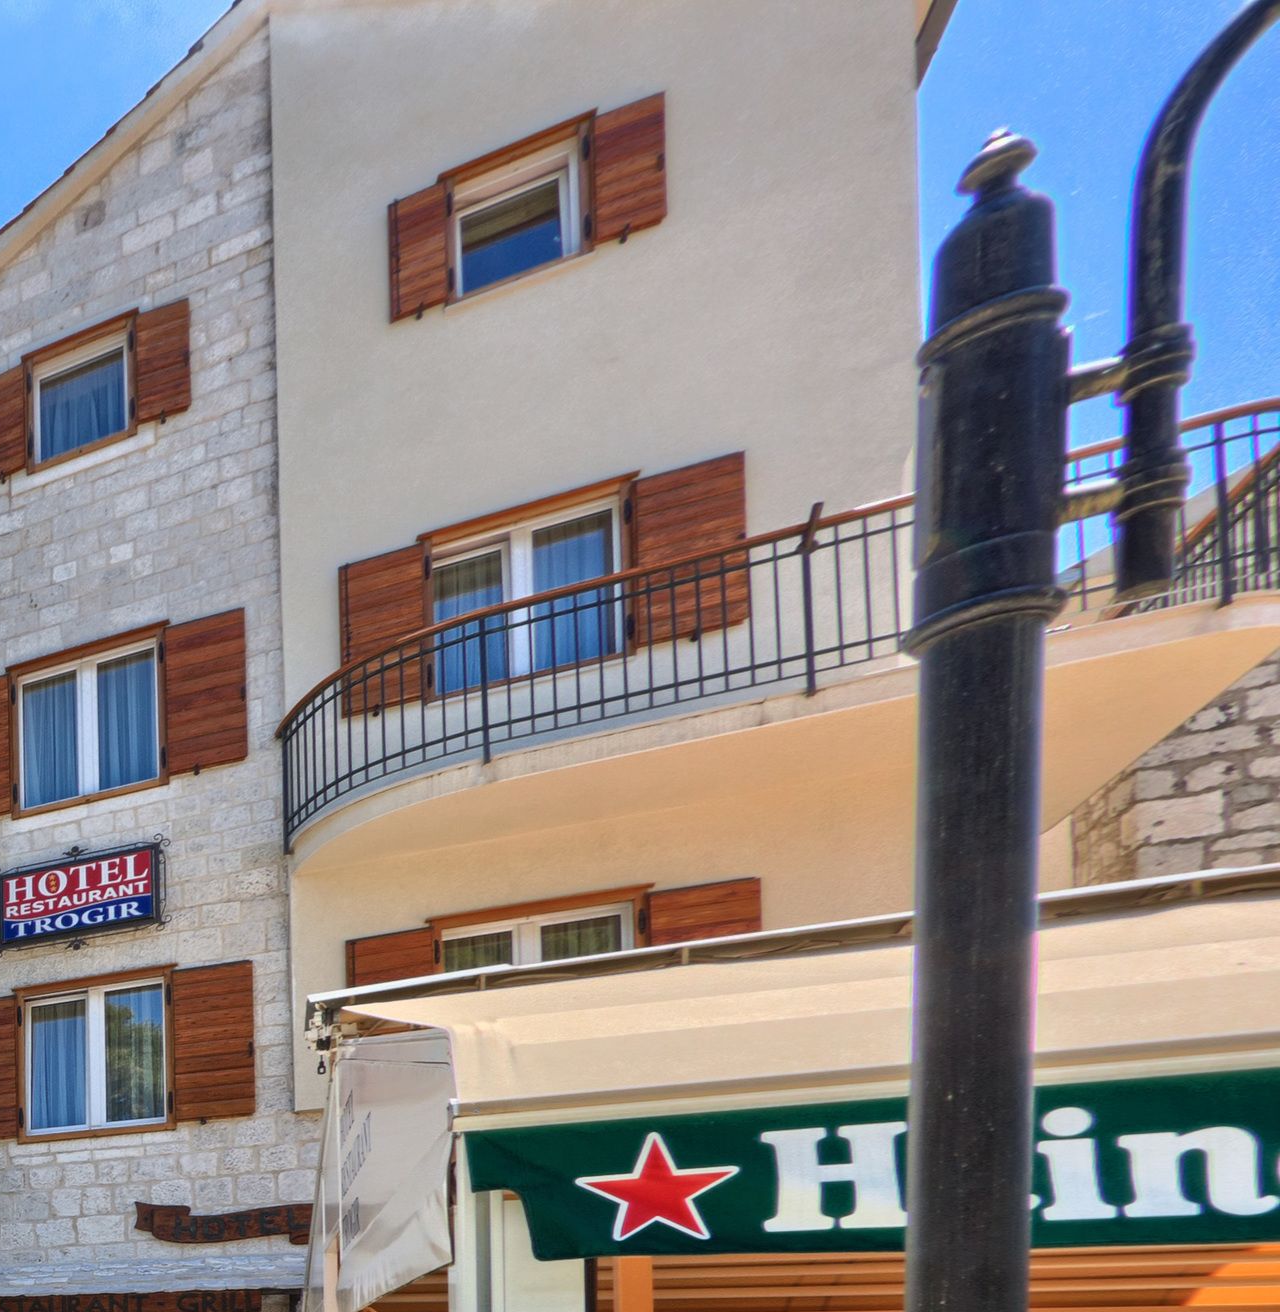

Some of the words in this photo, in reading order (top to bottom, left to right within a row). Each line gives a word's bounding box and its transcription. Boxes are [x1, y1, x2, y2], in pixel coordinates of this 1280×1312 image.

[5, 854, 150, 905] HOTEL
[5, 880, 148, 918] RESTAURANT
[10, 900, 143, 938] TROGIR
[759, 1106, 1280, 1233] Hin
[175, 1208, 311, 1240] HOTEL
[177, 1291, 261, 1312] GRILL
